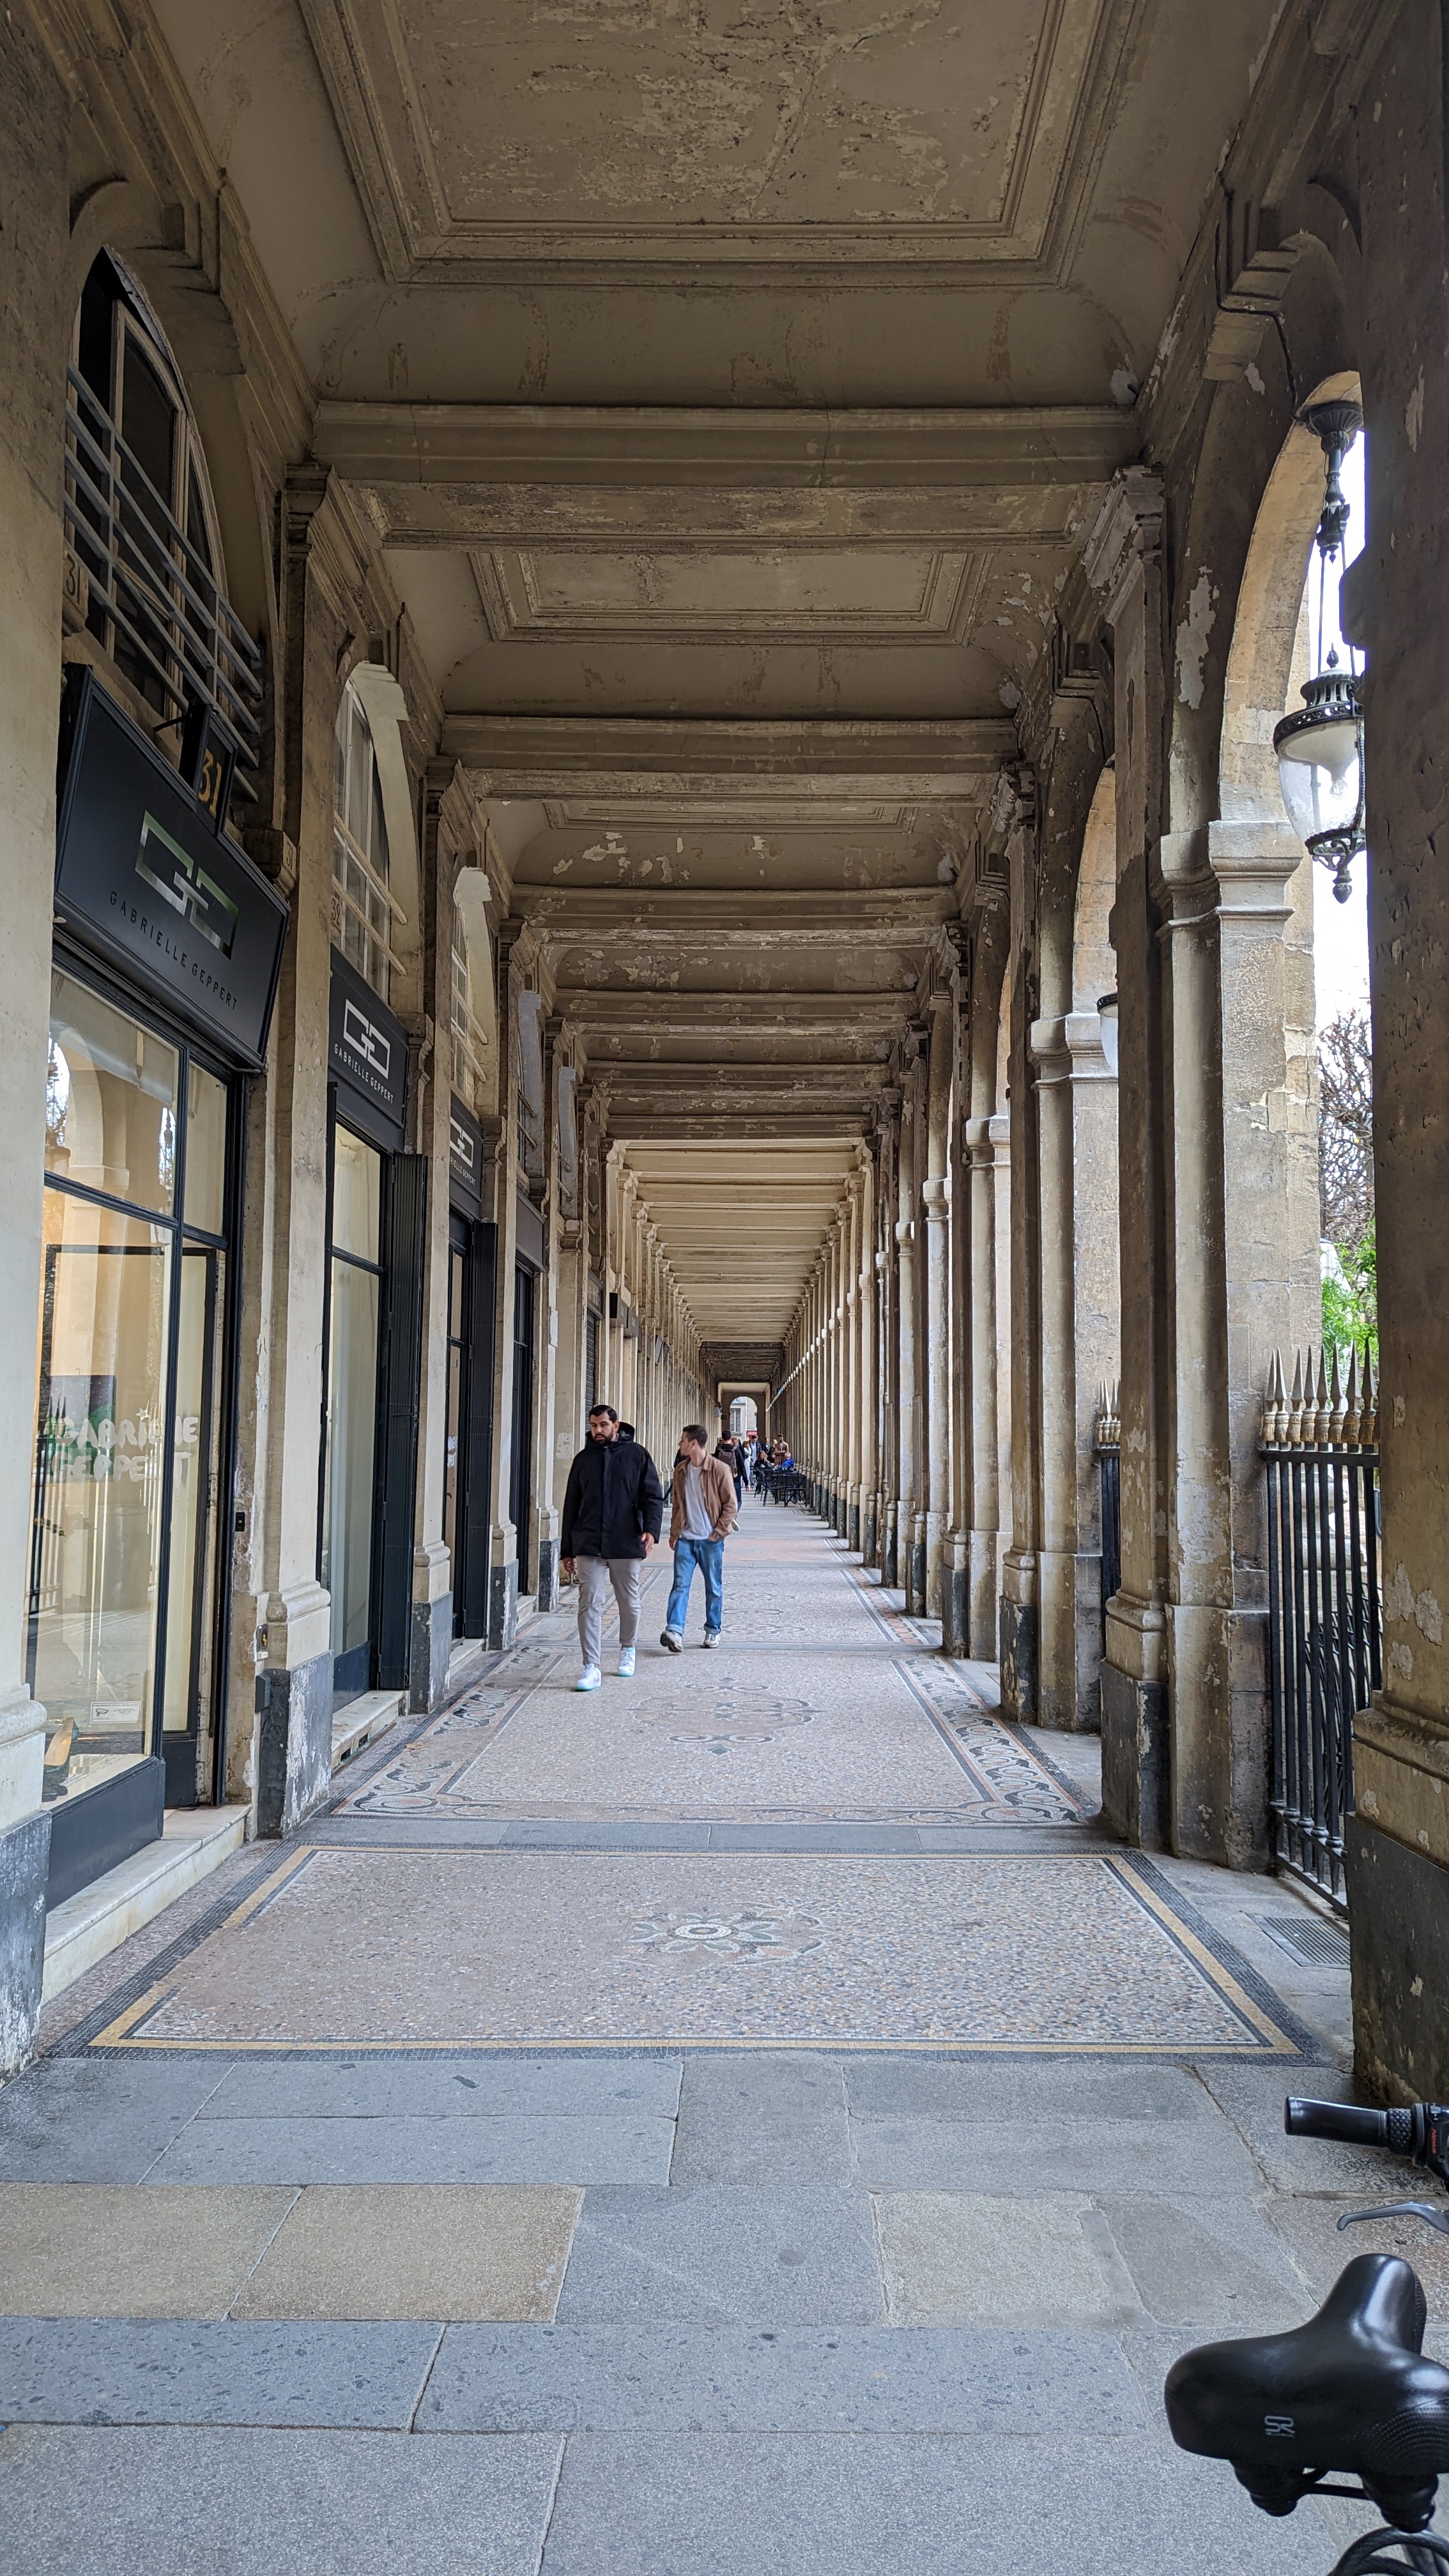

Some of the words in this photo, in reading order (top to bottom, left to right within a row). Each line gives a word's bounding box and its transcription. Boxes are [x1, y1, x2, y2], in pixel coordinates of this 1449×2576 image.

[66, 552, 80, 604] 31
[198, 747, 222, 818] 31
[109, 891, 187, 968] GABRIELLE
[192, 963, 238, 1010] GEPPERT
[334, 1043, 369, 1083] GABRIELLE
[370, 1077, 394, 1104] GEPPERT
[450, 1156, 463, 1174] RIELLE
[55, 1415, 199, 1450] GABRIELE
[51, 1451, 192, 1490] GEPPET
